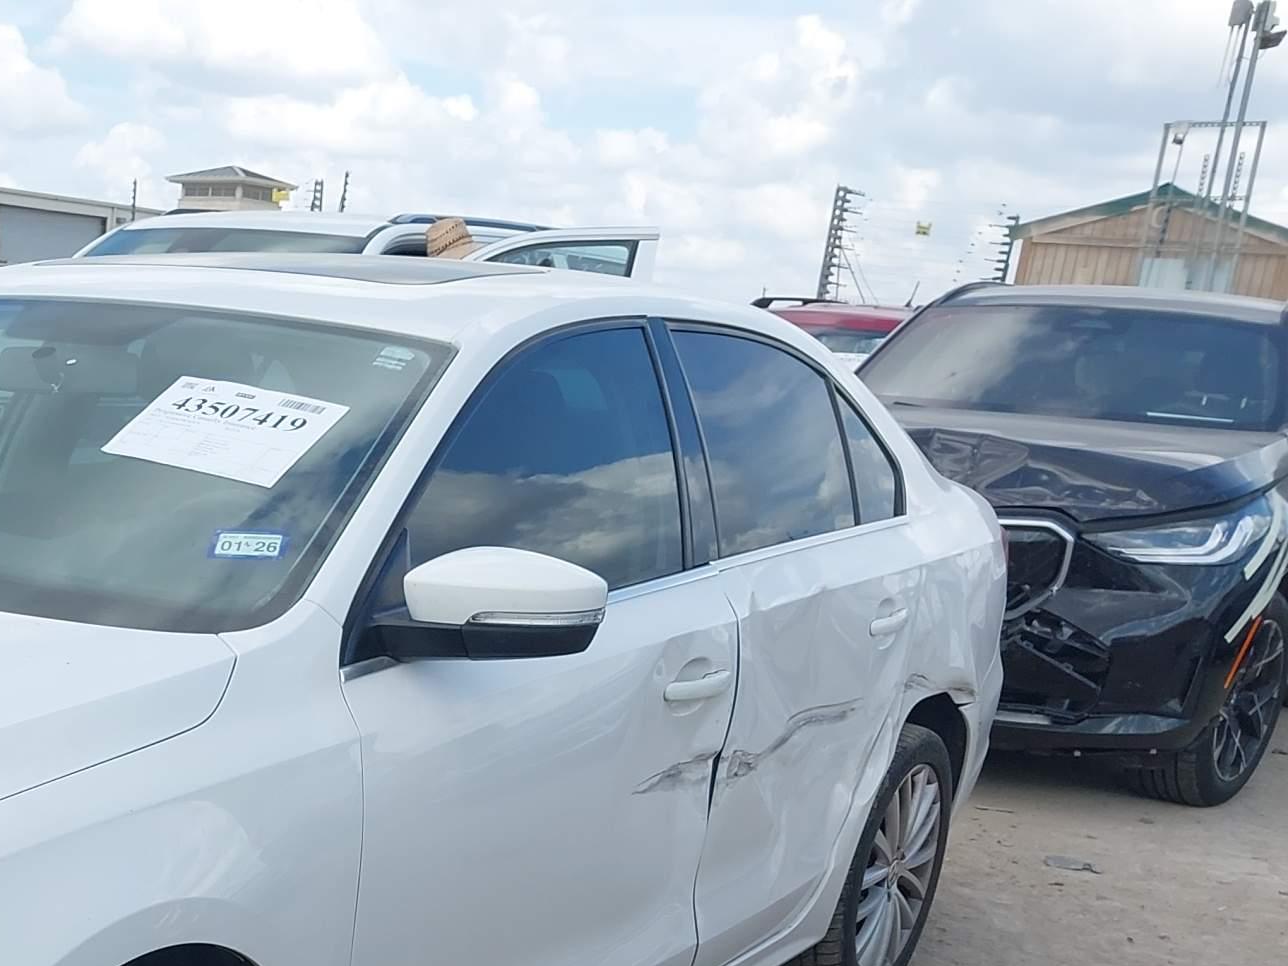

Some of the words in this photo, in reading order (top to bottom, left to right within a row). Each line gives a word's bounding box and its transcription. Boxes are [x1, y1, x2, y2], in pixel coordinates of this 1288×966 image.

[172, 396, 307, 432] 43507419
[220, 540, 242, 551] 01
[253, 541, 278, 552] 26
